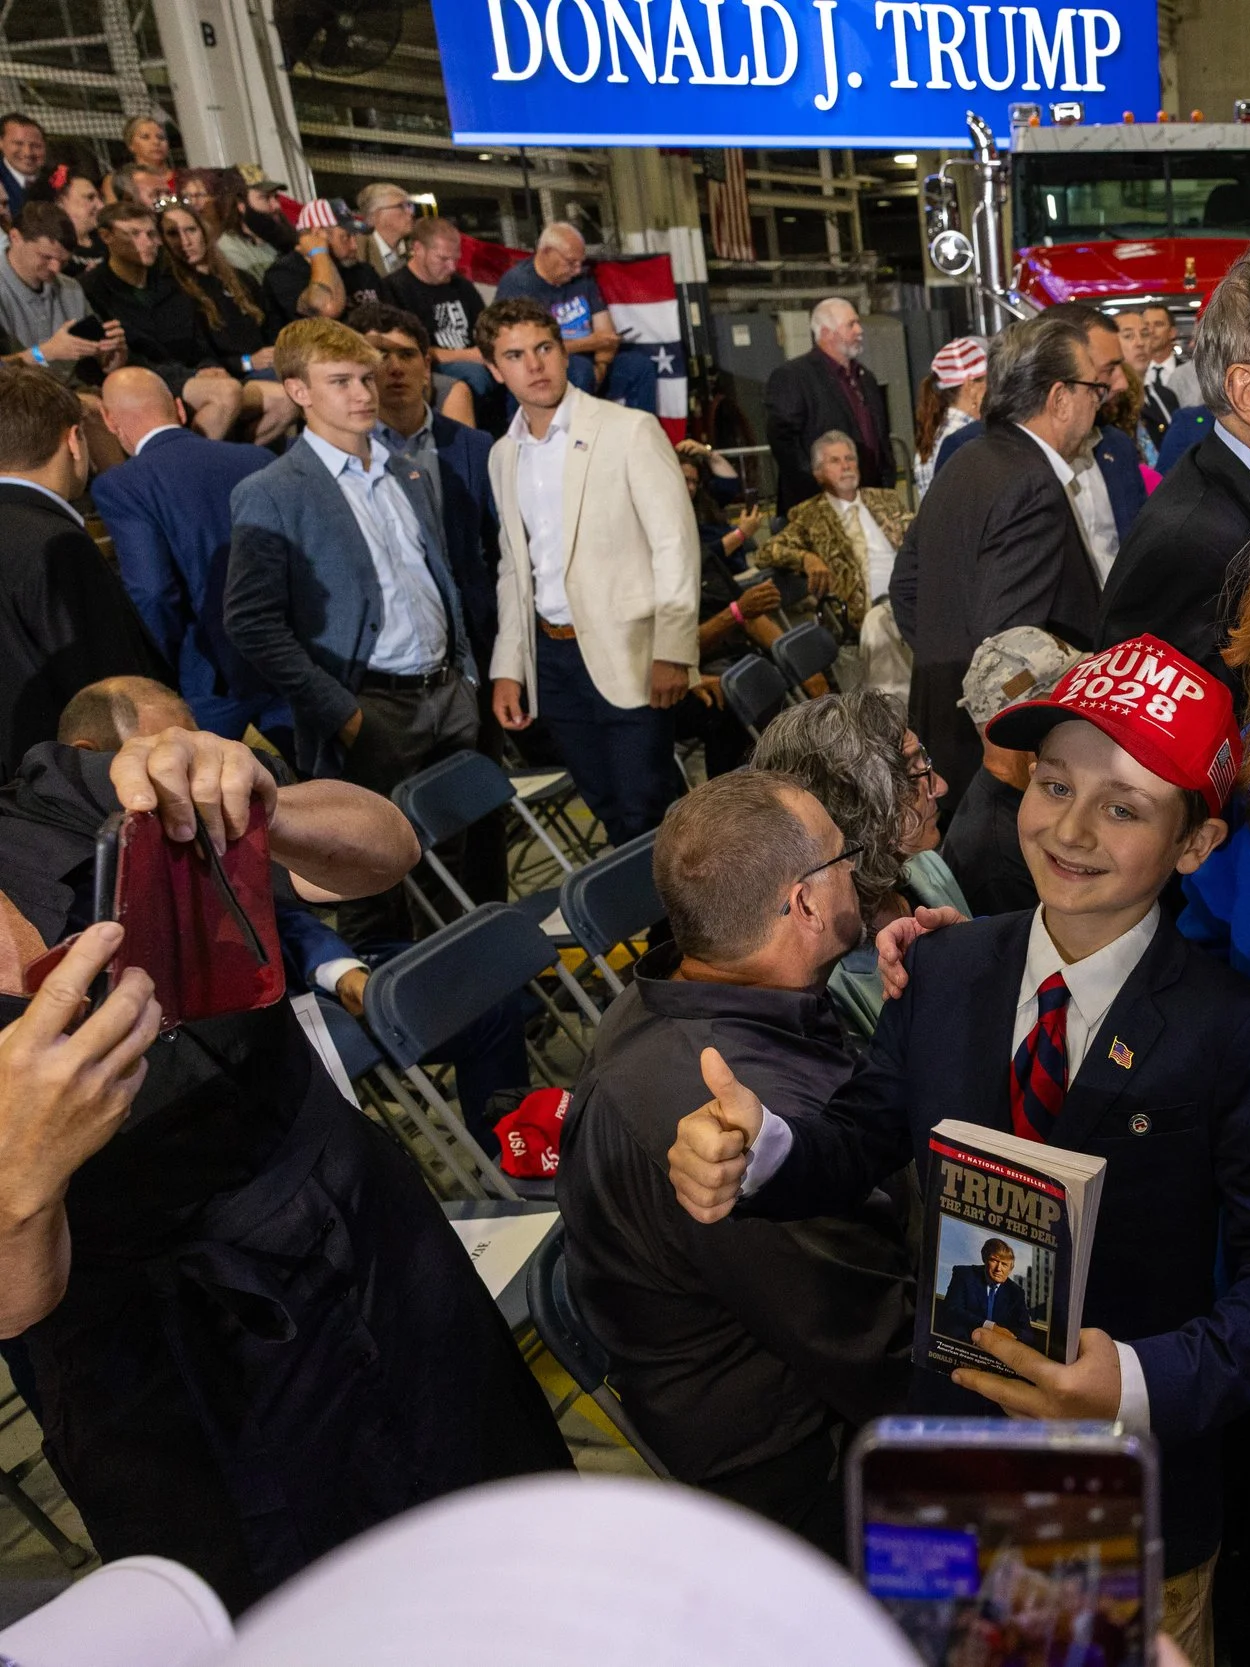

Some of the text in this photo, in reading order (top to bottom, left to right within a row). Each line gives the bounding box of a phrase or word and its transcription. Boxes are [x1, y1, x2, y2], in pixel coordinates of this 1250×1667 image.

[201, 21, 217, 48] B
[491, 0, 1122, 112] DONALD J. TRUMP
[1058, 676, 1178, 723] 2028
[1071, 650, 1205, 701] TRUMP
[508, 1131, 527, 1157] USA
[941, 1160, 1061, 1231] TRUMP
[967, 1156, 1005, 1173] NATIONAL
[1006, 1170, 1047, 1190] BESTSELLER
[939, 1195, 1058, 1248] THE ART OF THE DEAL
